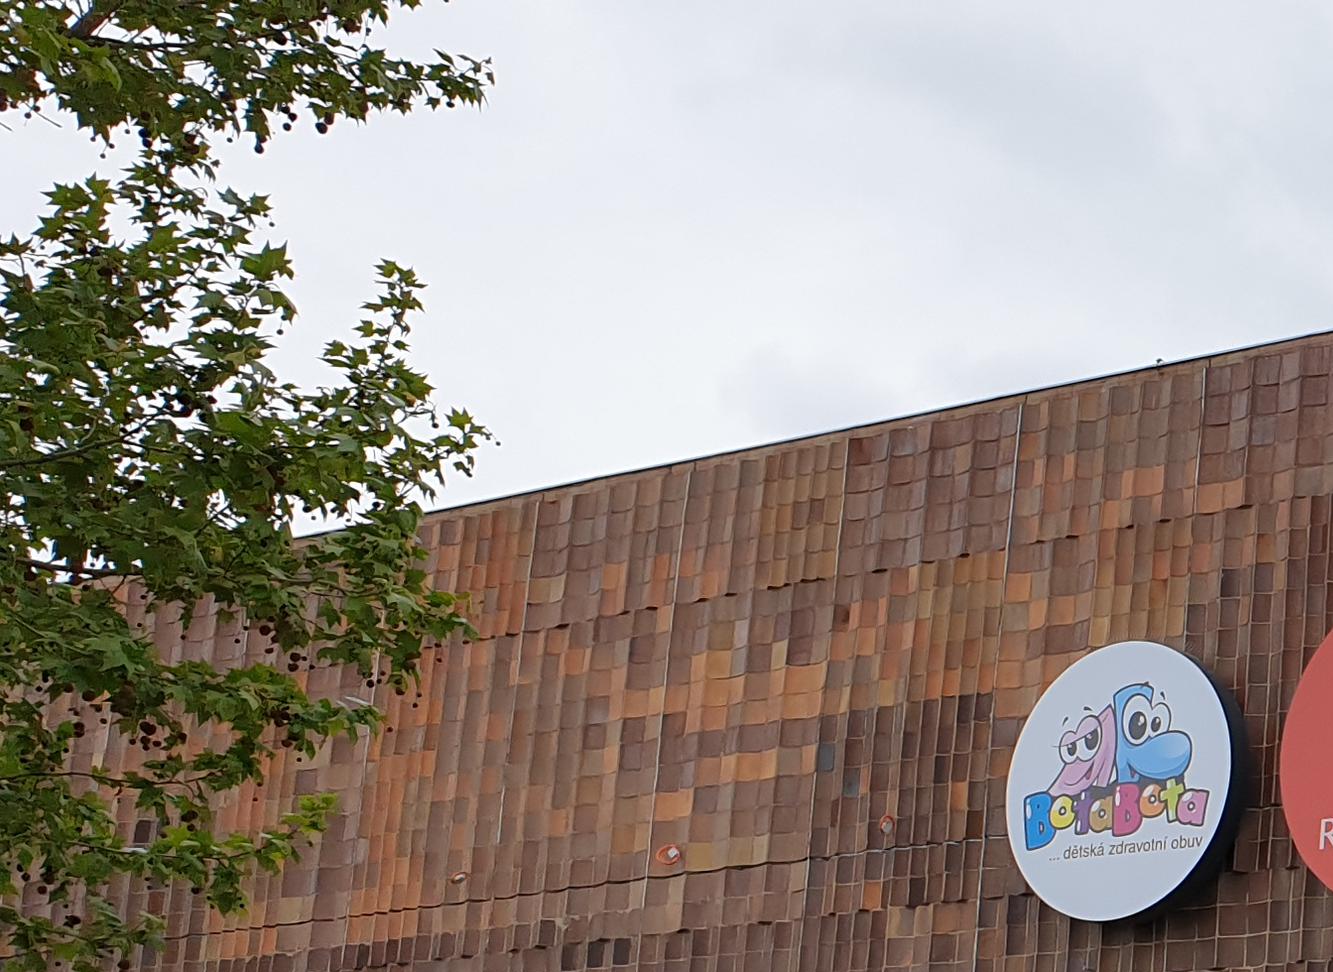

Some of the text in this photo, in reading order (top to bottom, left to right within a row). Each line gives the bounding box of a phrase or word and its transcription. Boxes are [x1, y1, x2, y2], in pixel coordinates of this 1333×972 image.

[1024, 777, 1210, 851] BotaBota
[1108, 836, 1167, 856] zdravotní
[1171, 834, 1203, 850] obuv
